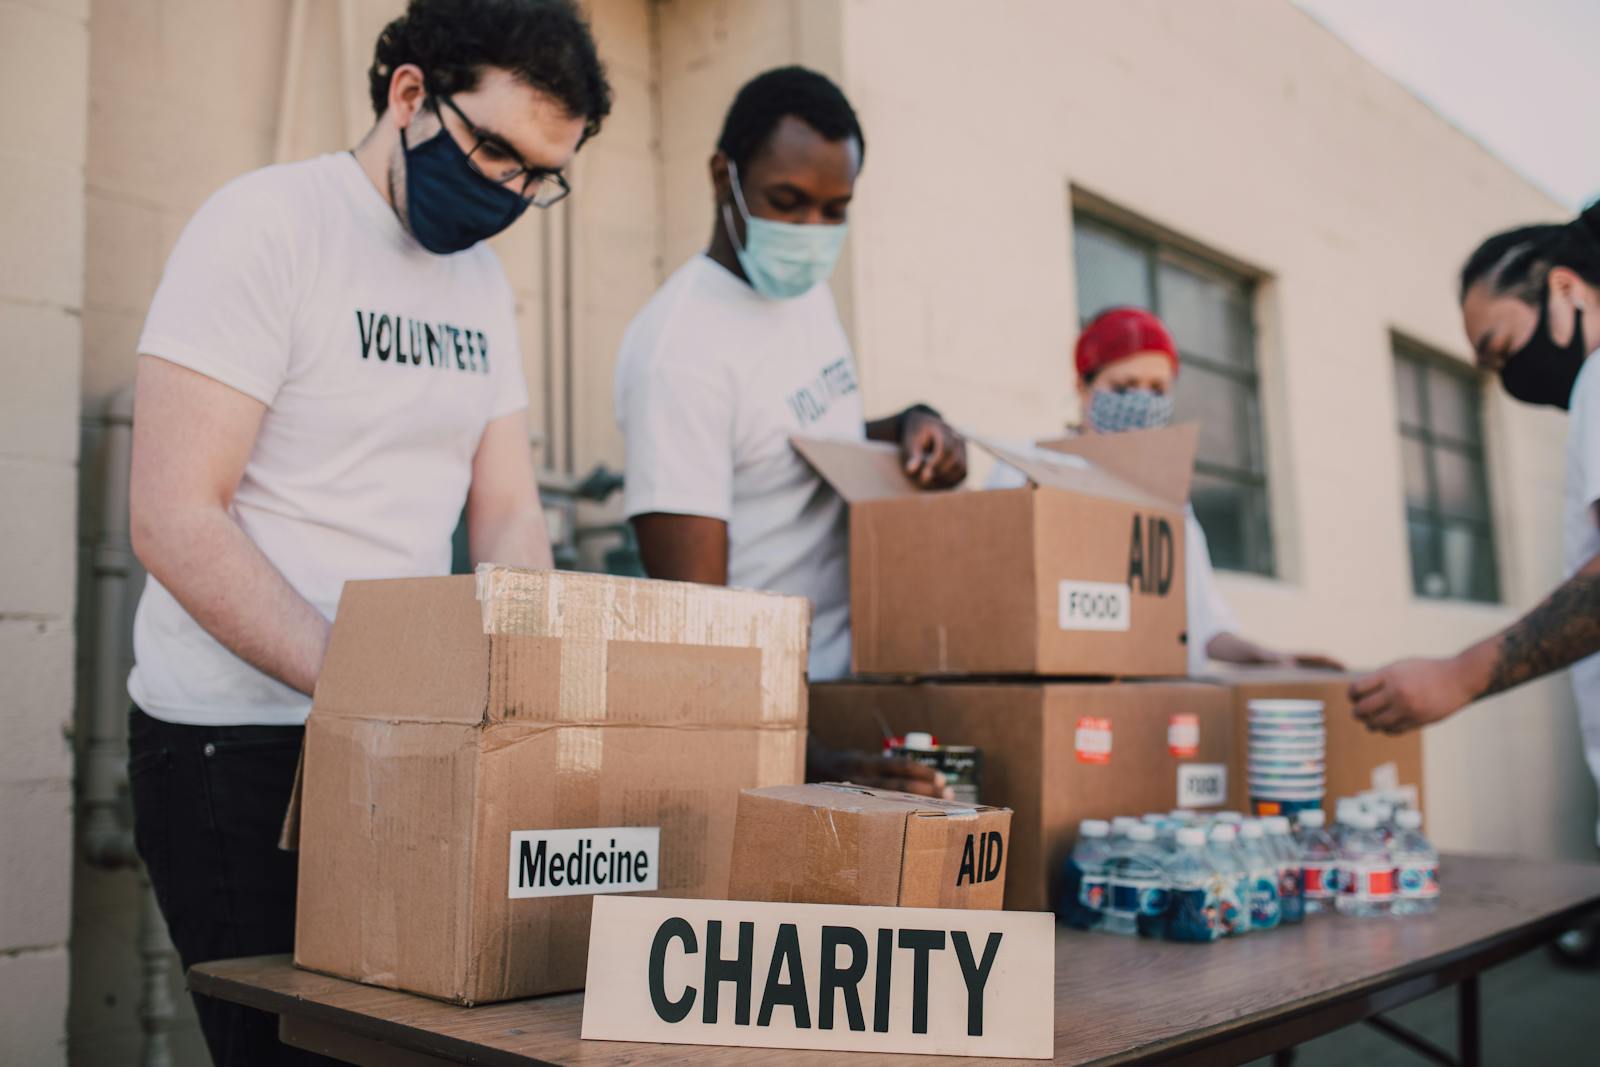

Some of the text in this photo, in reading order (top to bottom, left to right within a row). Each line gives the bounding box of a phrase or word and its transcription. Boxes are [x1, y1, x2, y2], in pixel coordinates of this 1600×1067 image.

[356, 310, 490, 374] VOLUNTEER
[1127, 511, 1175, 597] AID
[1069, 591, 1121, 619] FOOD
[518, 838, 649, 888] Medicine
[956, 830, 1004, 887] AID
[648, 916, 1004, 1037] CHARITY
